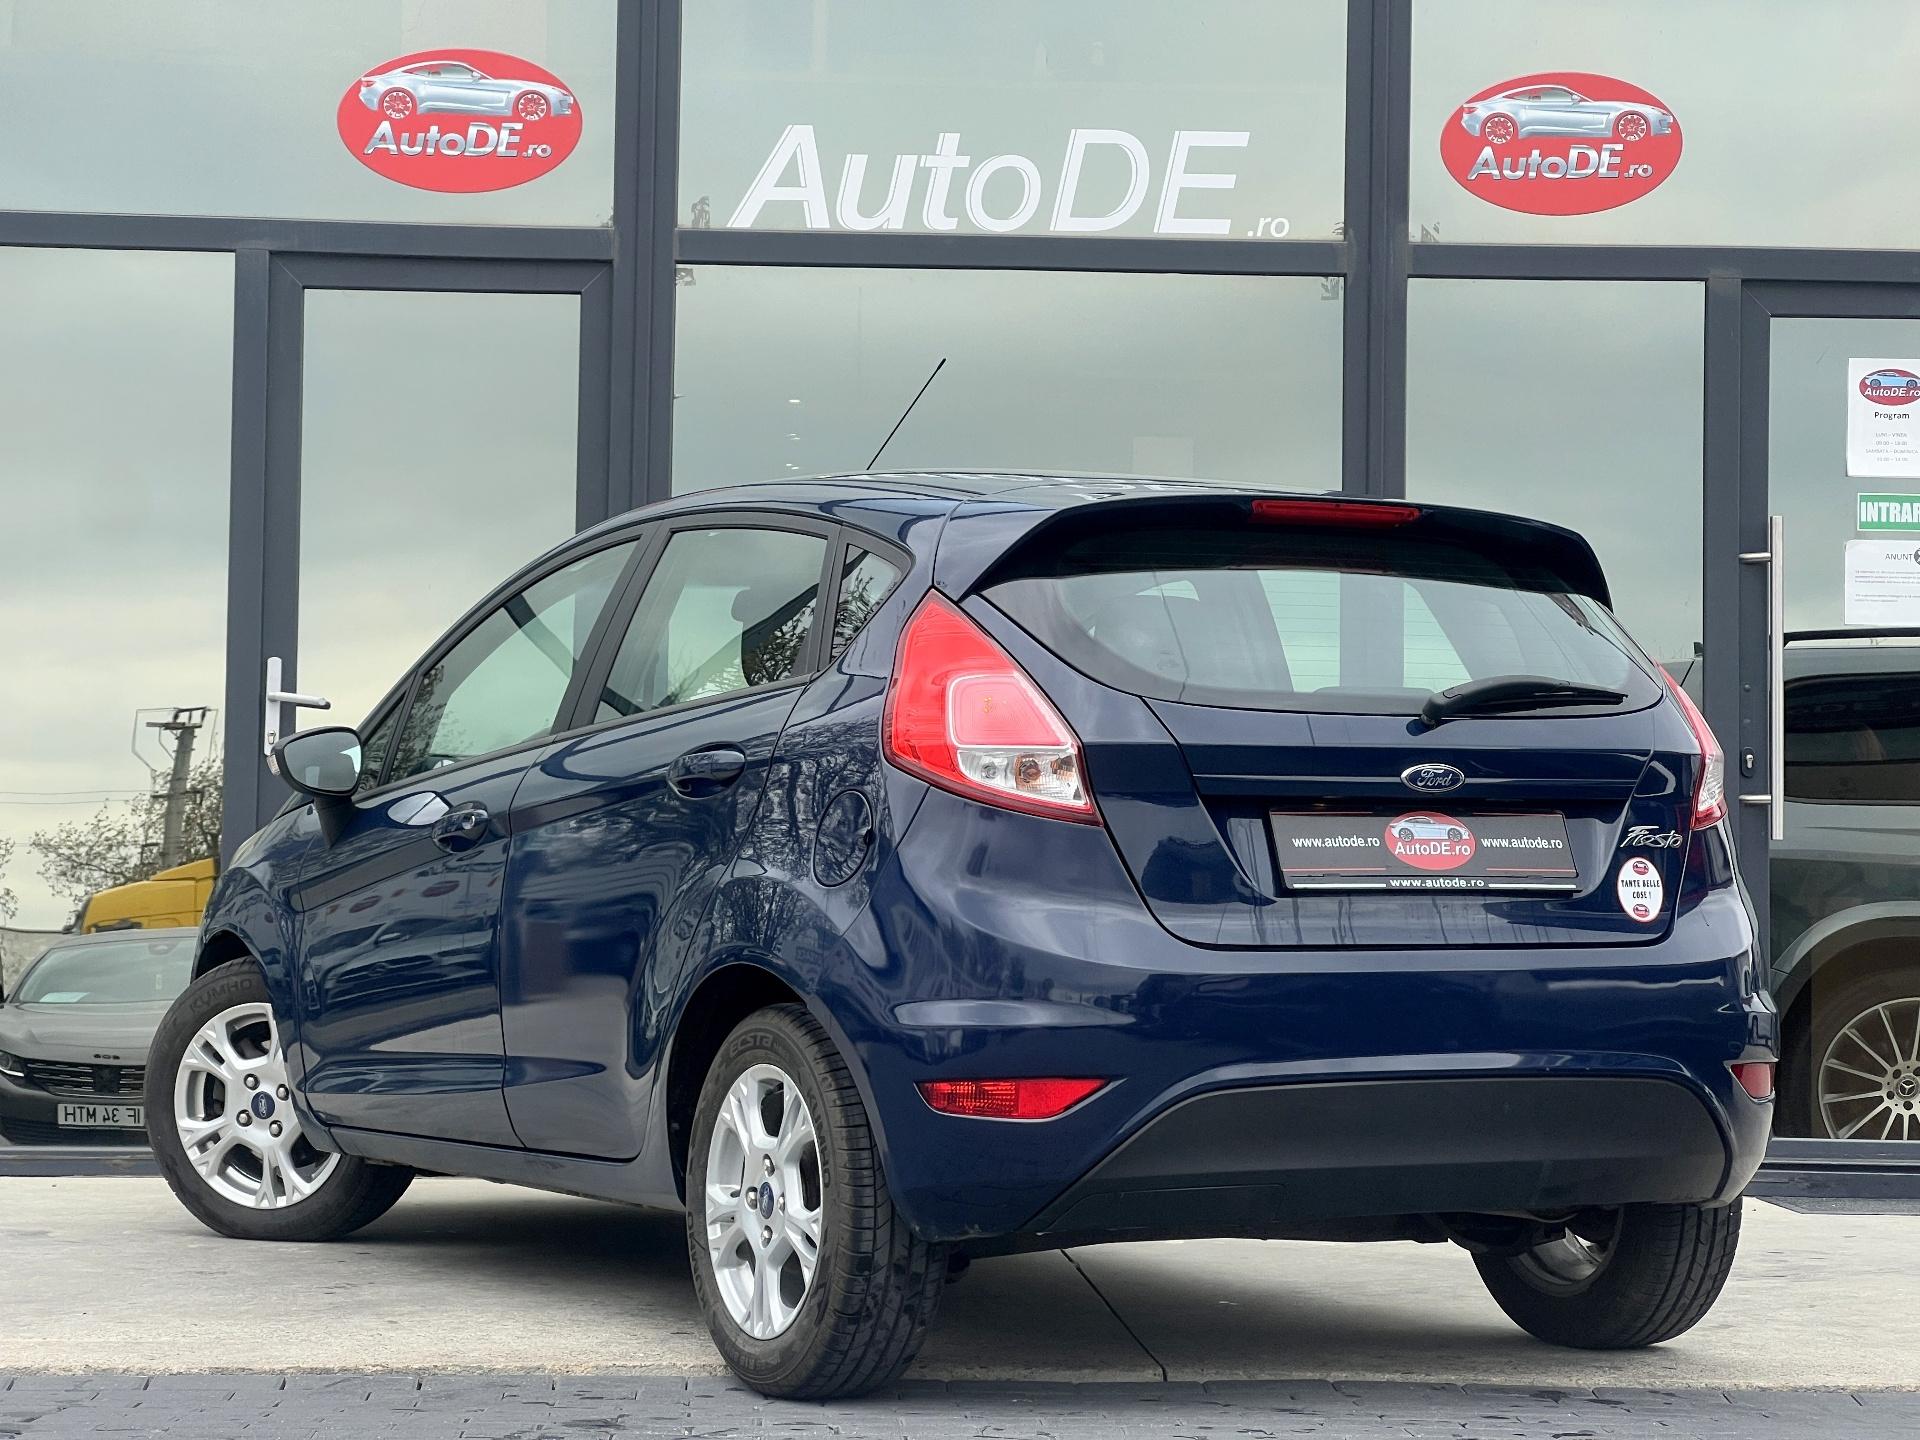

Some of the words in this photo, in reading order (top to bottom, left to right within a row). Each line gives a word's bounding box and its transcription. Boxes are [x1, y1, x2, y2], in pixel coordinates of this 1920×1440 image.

[1874, 411, 1910, 420] Program
[1416, 768, 1453, 787] Ford
[1292, 834, 1381, 848] www.autode.ro
[1481, 836, 1563, 849] www.autode.ro
[1620, 826, 1683, 848] Fiesta
[1395, 841, 1471, 855] AutoDE.ro
[1390, 877, 1485, 888] www.autode.ro
[1621, 880, 1641, 888] TANTE
[1643, 880, 1661, 888] BELLE
